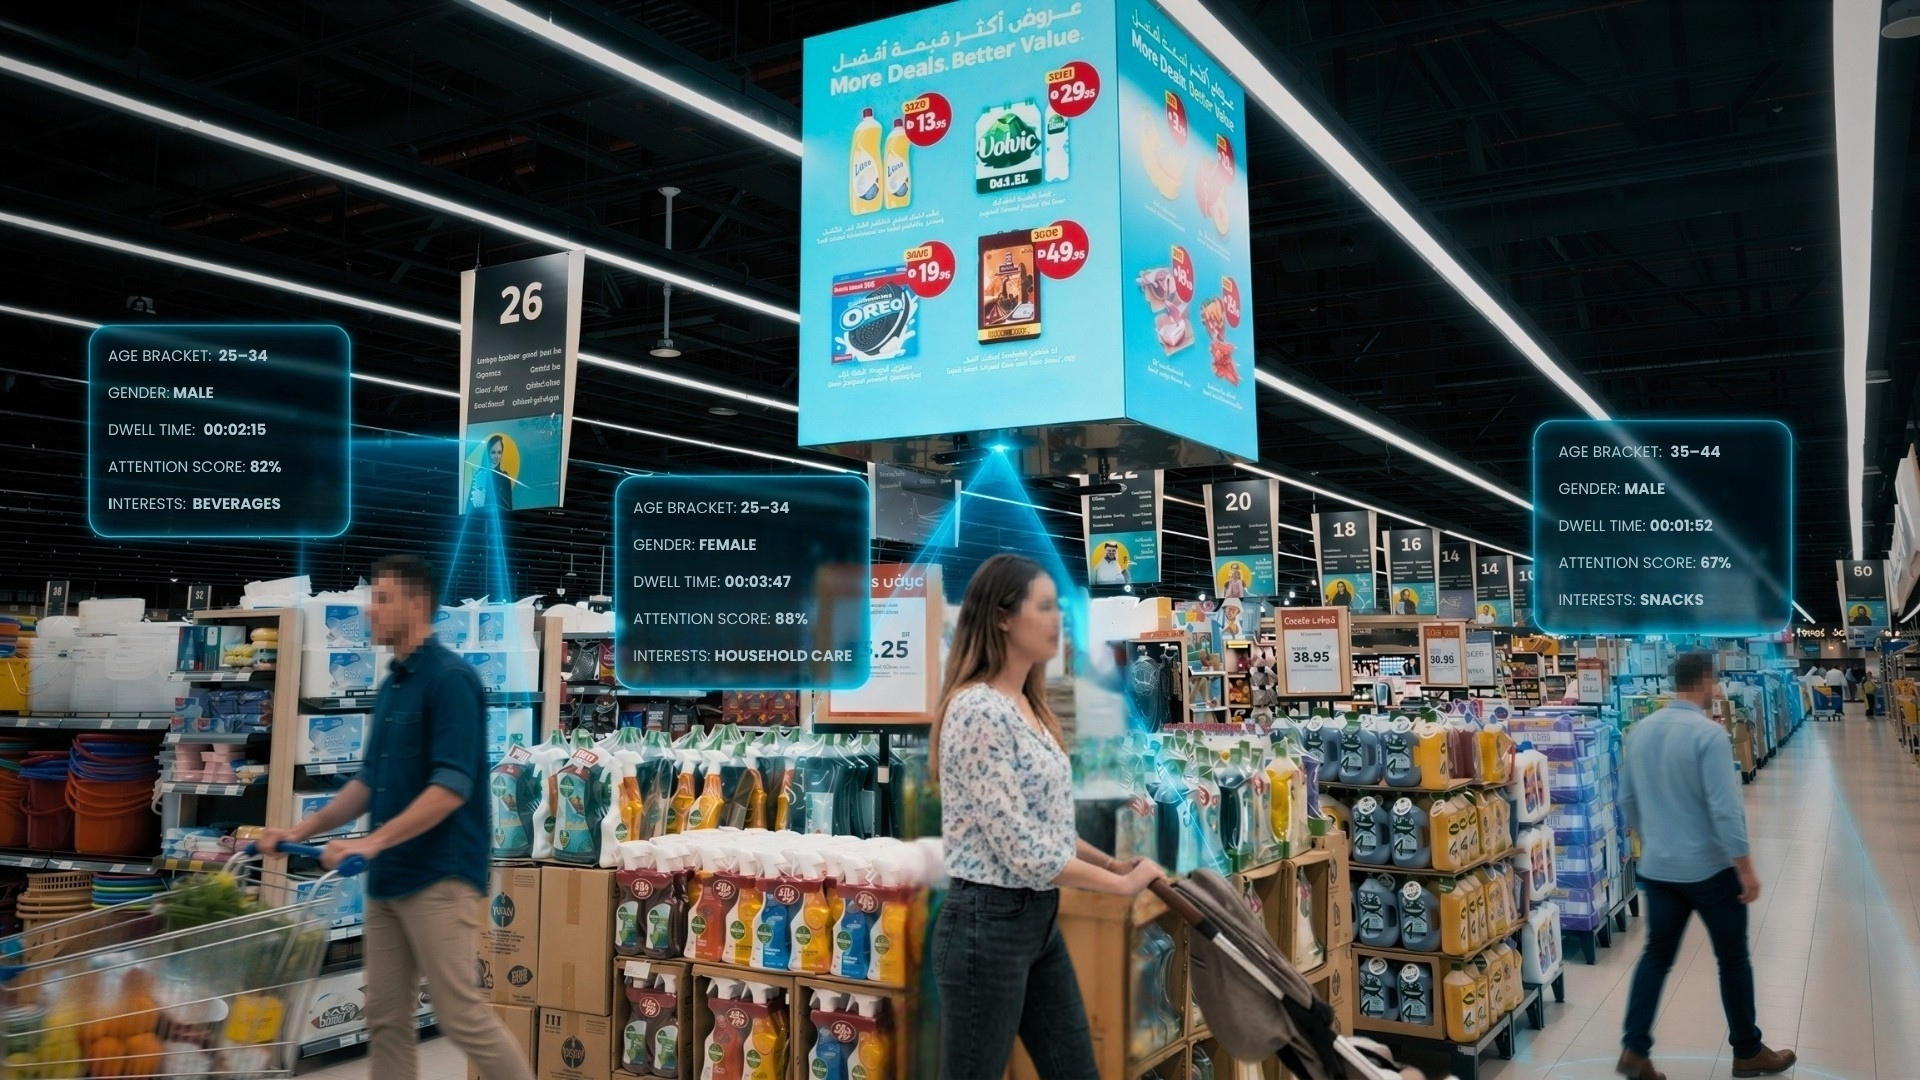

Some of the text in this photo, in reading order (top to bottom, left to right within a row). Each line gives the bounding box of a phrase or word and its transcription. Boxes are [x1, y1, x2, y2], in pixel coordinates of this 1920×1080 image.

[830, 71, 882, 97] More
[951, 41, 1016, 70] Better
[978, 130, 1037, 159] Volvic
[500, 281, 543, 325] 26
[842, 298, 903, 328] OREO
[1225, 491, 1252, 512] 20
[1333, 521, 1357, 538] 18
[1401, 537, 1422, 552] 16
[1441, 549, 1461, 563] 14
[1480, 562, 1499, 575] 14
[1293, 651, 1330, 663] 38.95
